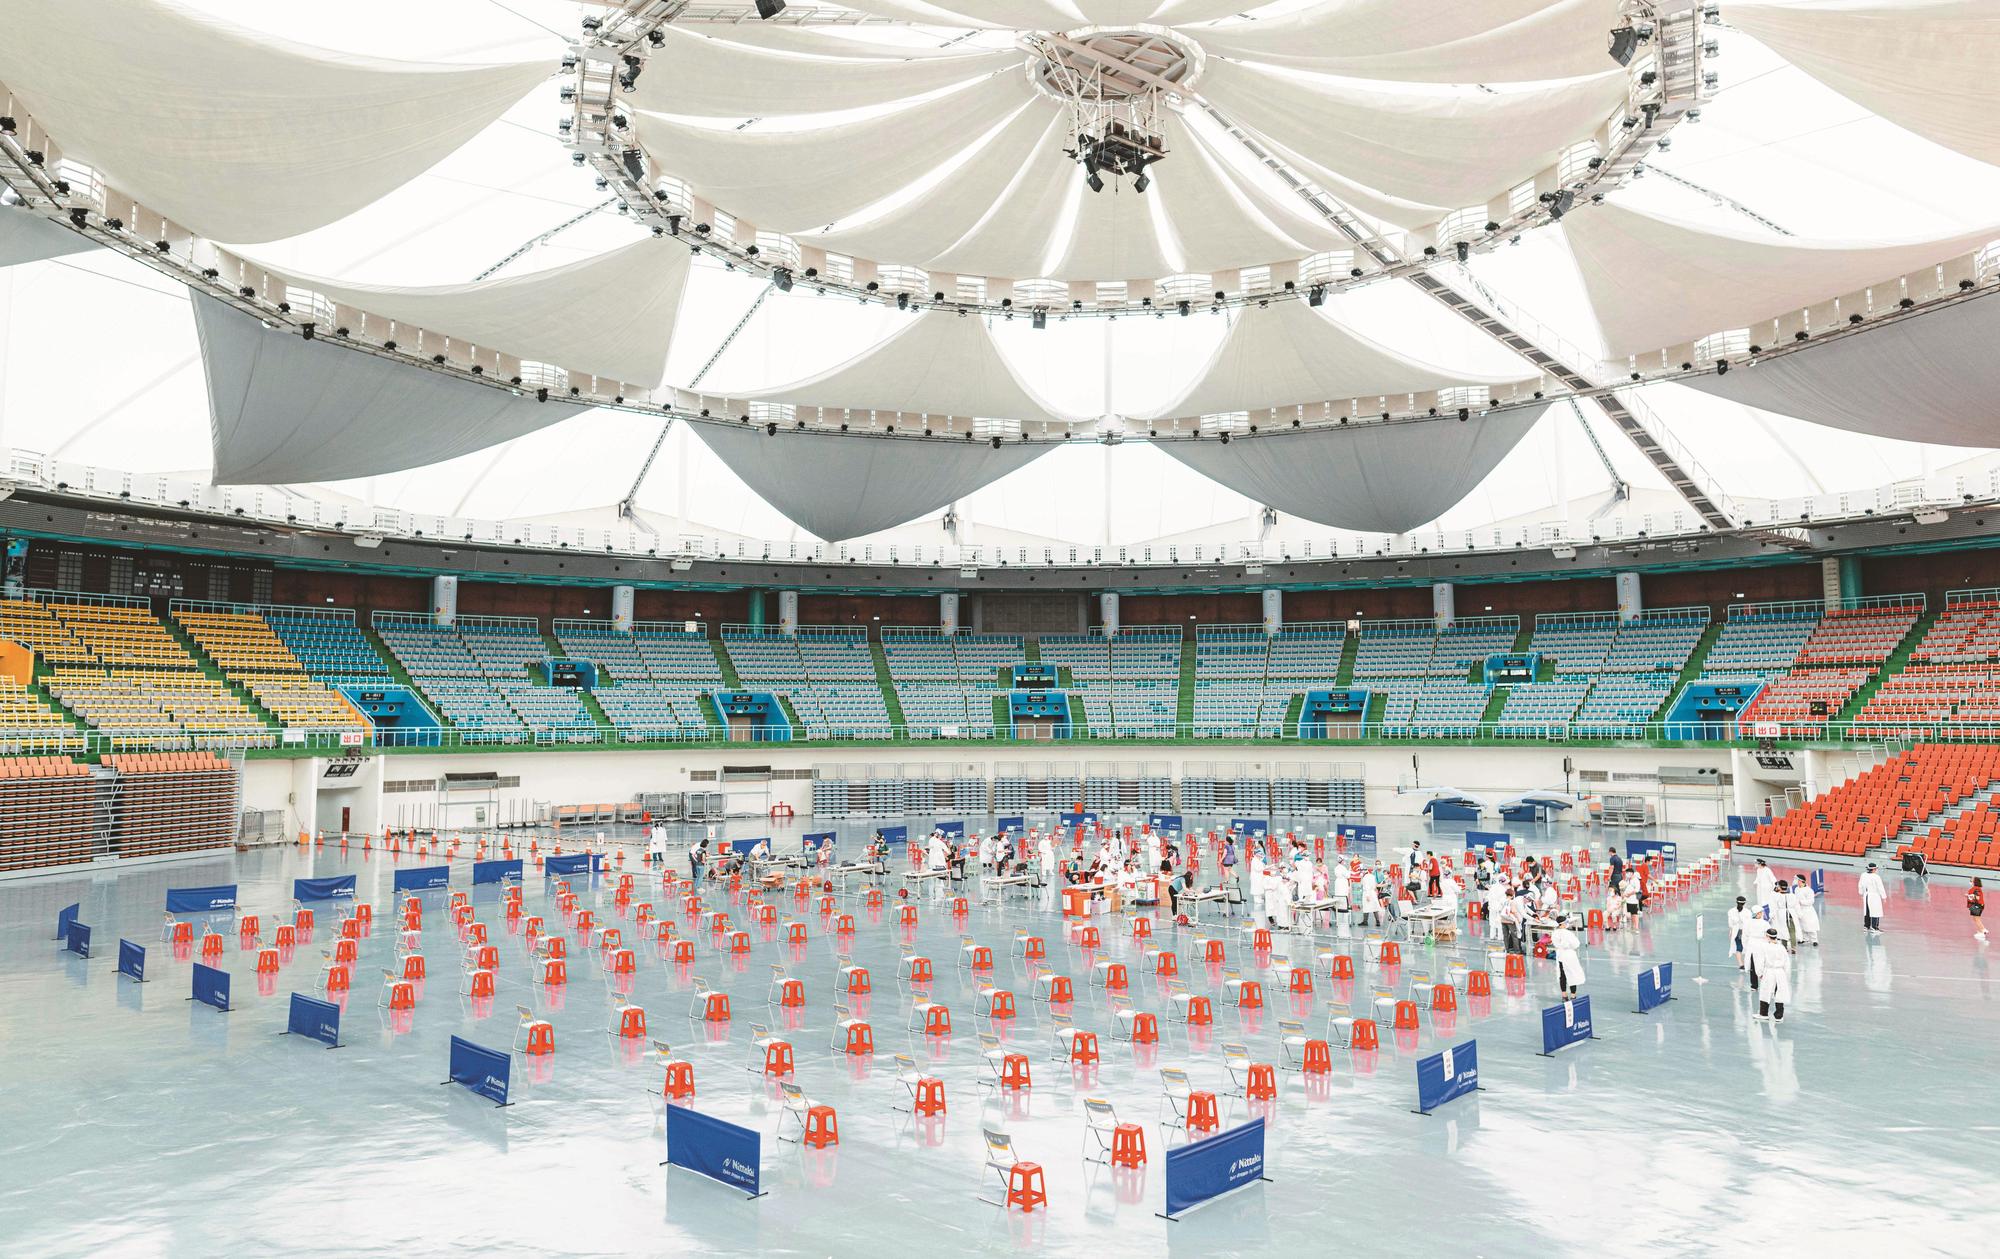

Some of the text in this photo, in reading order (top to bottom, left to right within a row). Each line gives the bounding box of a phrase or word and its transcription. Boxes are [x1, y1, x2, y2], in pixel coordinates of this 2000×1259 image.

[1758, 726, 1778, 735] 出口
[343, 735, 361, 743] 出口
[1762, 757, 1787, 765] 北門
